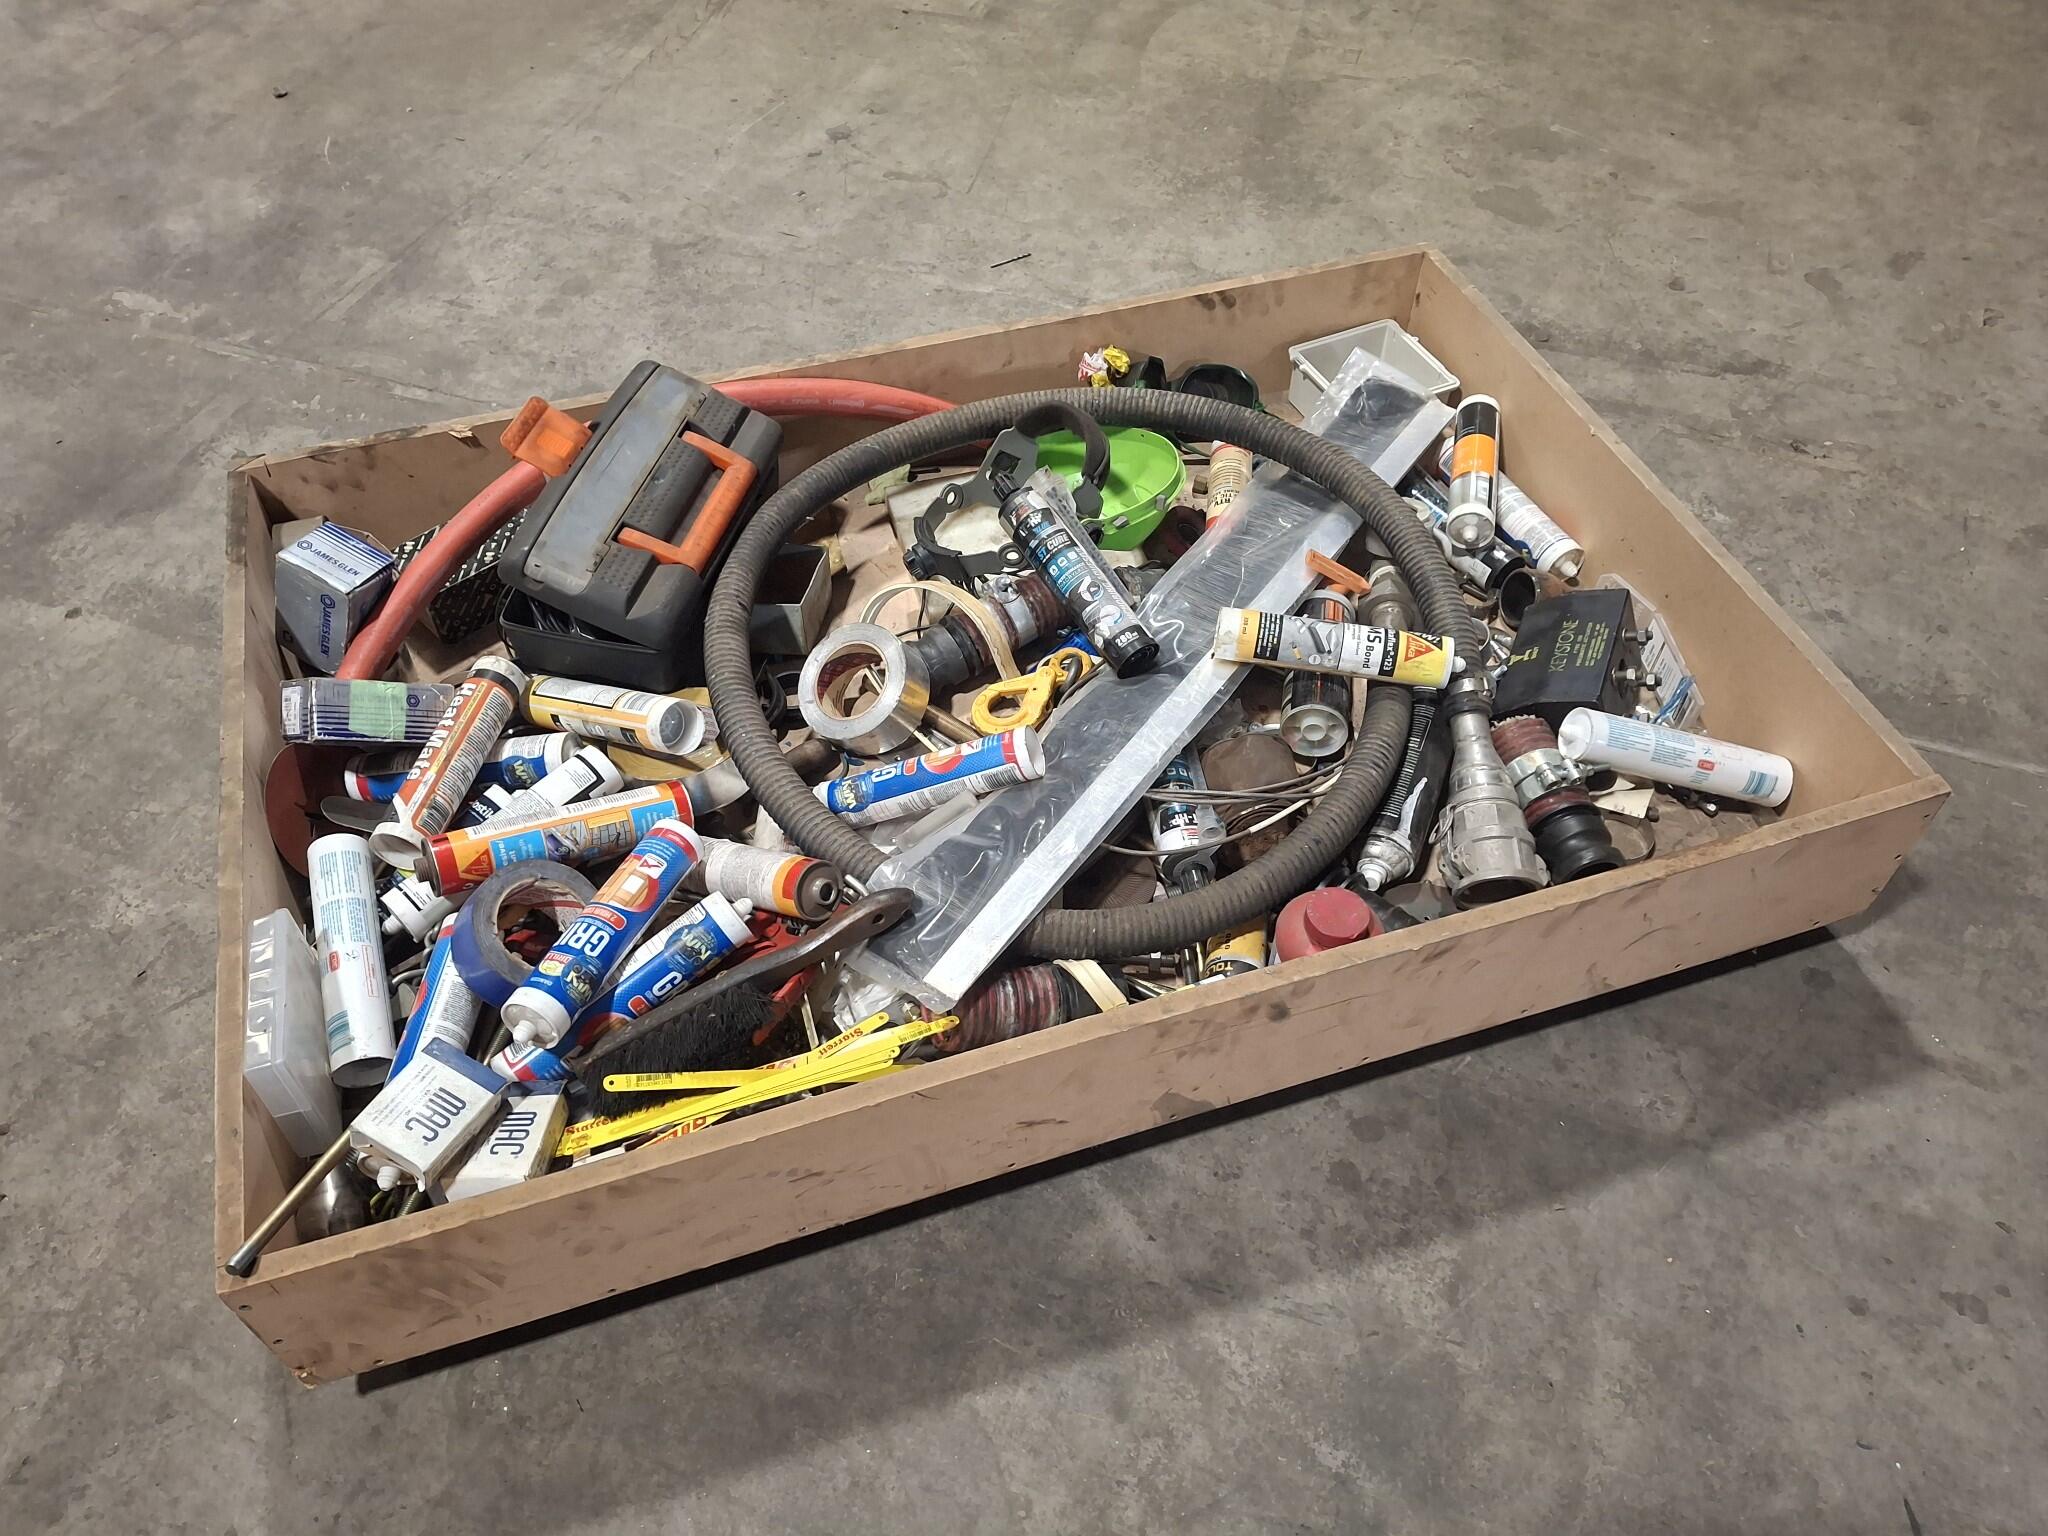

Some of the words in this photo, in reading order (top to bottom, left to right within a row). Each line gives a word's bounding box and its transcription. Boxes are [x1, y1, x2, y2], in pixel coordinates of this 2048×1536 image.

[1047, 533, 1069, 551] CURE
[1367, 627, 1382, 644] MS
[1406, 638, 1427, 659] Sika
[1548, 619, 1579, 672] KEYSTONE
[1363, 645, 1375, 669] Bond
[437, 682, 477, 729] Heat
[406, 727, 449, 781] Mate
[681, 928, 712, 961] WIN
[819, 1027, 865, 1057] Starrett
[404, 1086, 467, 1143] MAC
[564, 1114, 614, 1137] Starre
[490, 1111, 538, 1156] MAC
